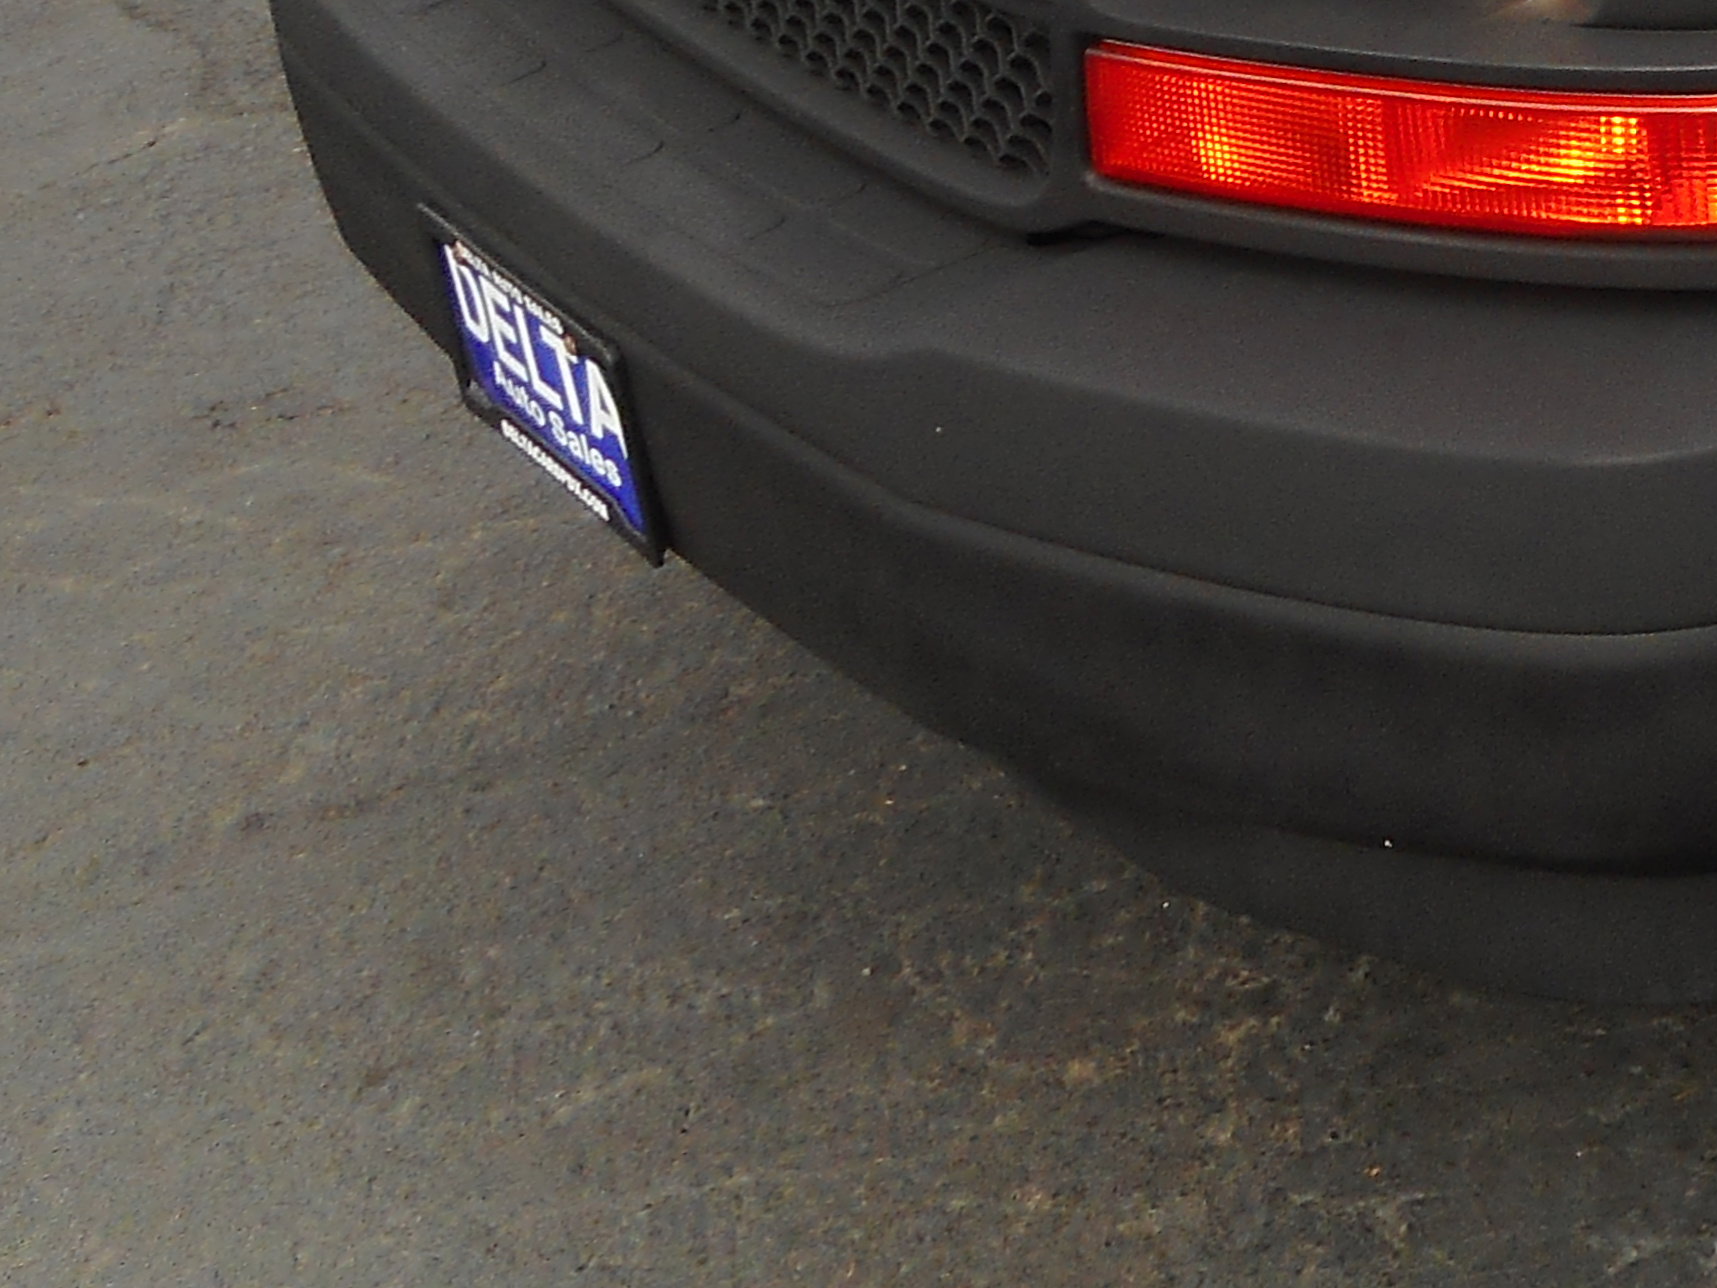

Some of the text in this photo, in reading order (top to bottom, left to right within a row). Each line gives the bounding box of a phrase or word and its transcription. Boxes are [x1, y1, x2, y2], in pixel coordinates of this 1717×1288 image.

[443, 243, 629, 460] DELTA
[493, 360, 546, 427] Auto
[548, 410, 622, 487] Sales
